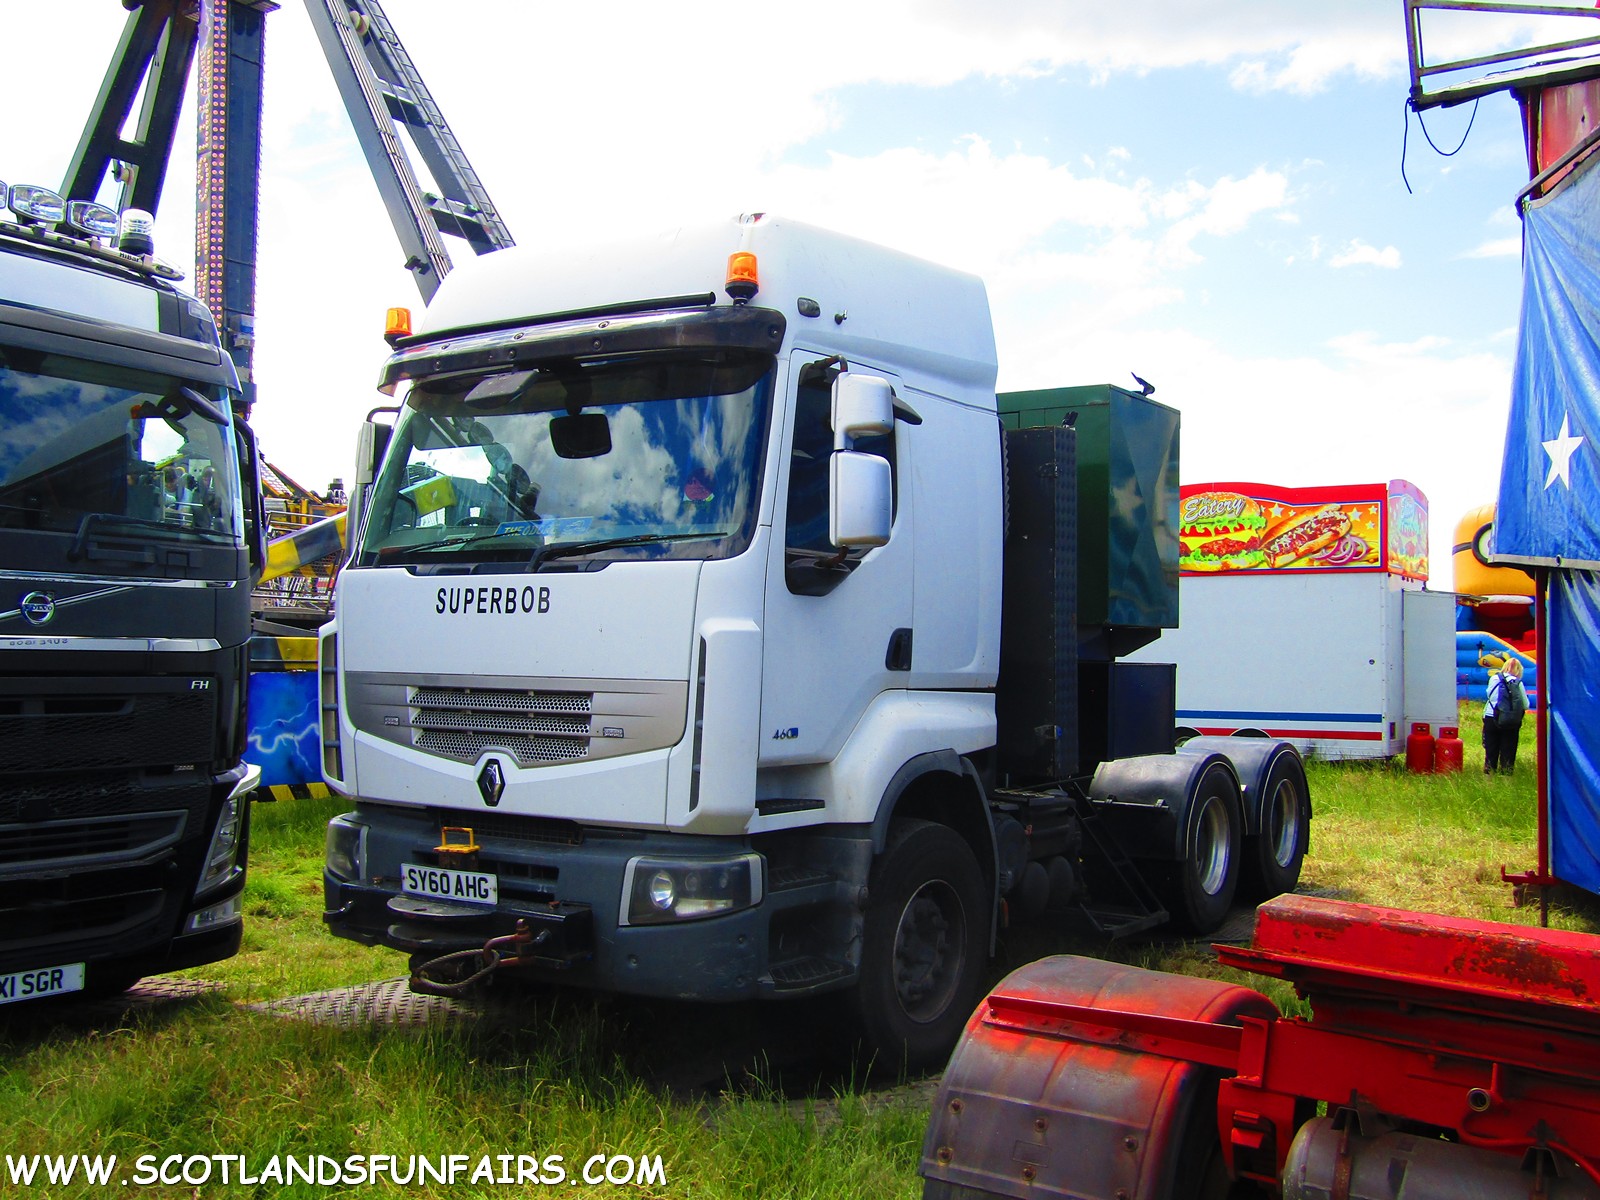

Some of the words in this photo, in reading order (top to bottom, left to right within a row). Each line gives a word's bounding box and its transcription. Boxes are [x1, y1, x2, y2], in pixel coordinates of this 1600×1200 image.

[1184, 498, 1246, 523] Eatery
[23, 603, 54, 612] VOLVO
[435, 585, 551, 614] SUPERBOB
[191, 680, 210, 690] FH
[772, 728, 793, 740] 460
[408, 868, 451, 895] SY60
[454, 874, 489, 899] AHG
[21, 968, 64, 995] SGR
